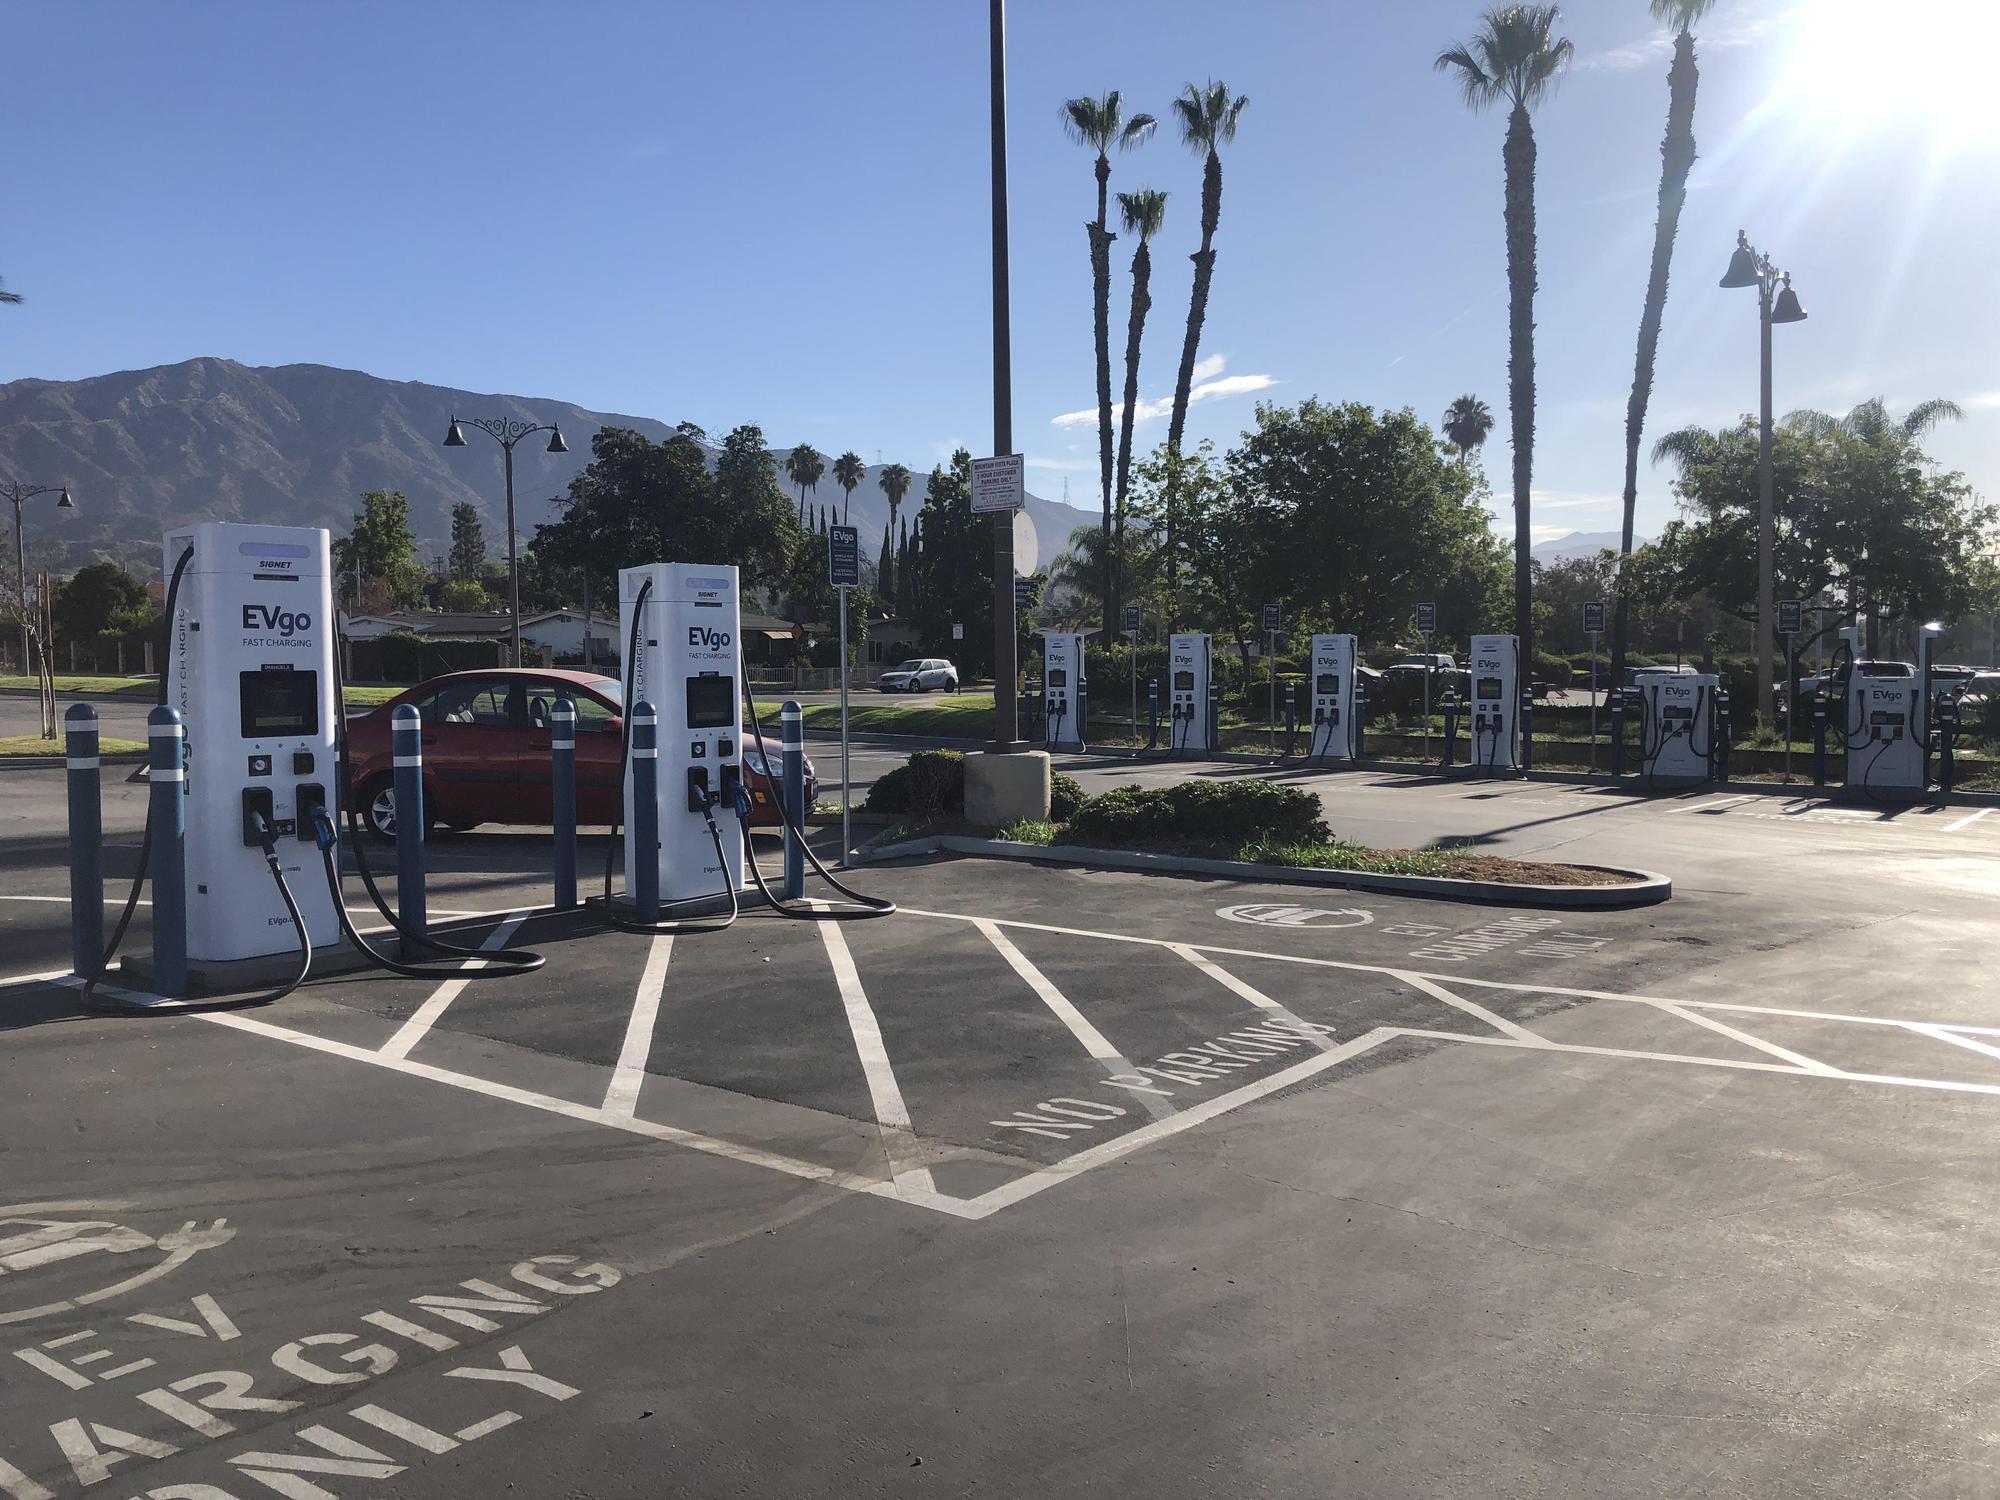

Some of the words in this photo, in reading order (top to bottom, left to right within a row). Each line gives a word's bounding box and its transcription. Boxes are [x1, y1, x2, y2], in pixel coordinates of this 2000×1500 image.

[834, 530, 854, 543] EVgo
[259, 560, 292, 569] SIGNET
[242, 604, 311, 637] EVgo
[178, 608, 186, 684] CHARGING
[243, 639, 264, 647] FAST
[688, 626, 730, 651] EVgo
[1175, 656, 1192, 664] EVgo
[1318, 658, 1338, 666] EVgo
[1478, 660, 1500, 670] EVgo
[1666, 687, 1690, 697] EVgo
[1873, 690, 1902, 702] EVgo
[1379, 922, 1450, 937] EV
[1408, 916, 1562, 961] CHARGING
[1515, 932, 1614, 959] ONLY
[989, 1098, 1127, 1139] NO
[1099, 1018, 1336, 1096] PARKING
[12, 1293, 242, 1391] EV
[127, 1345, 582, 1500] NLY
